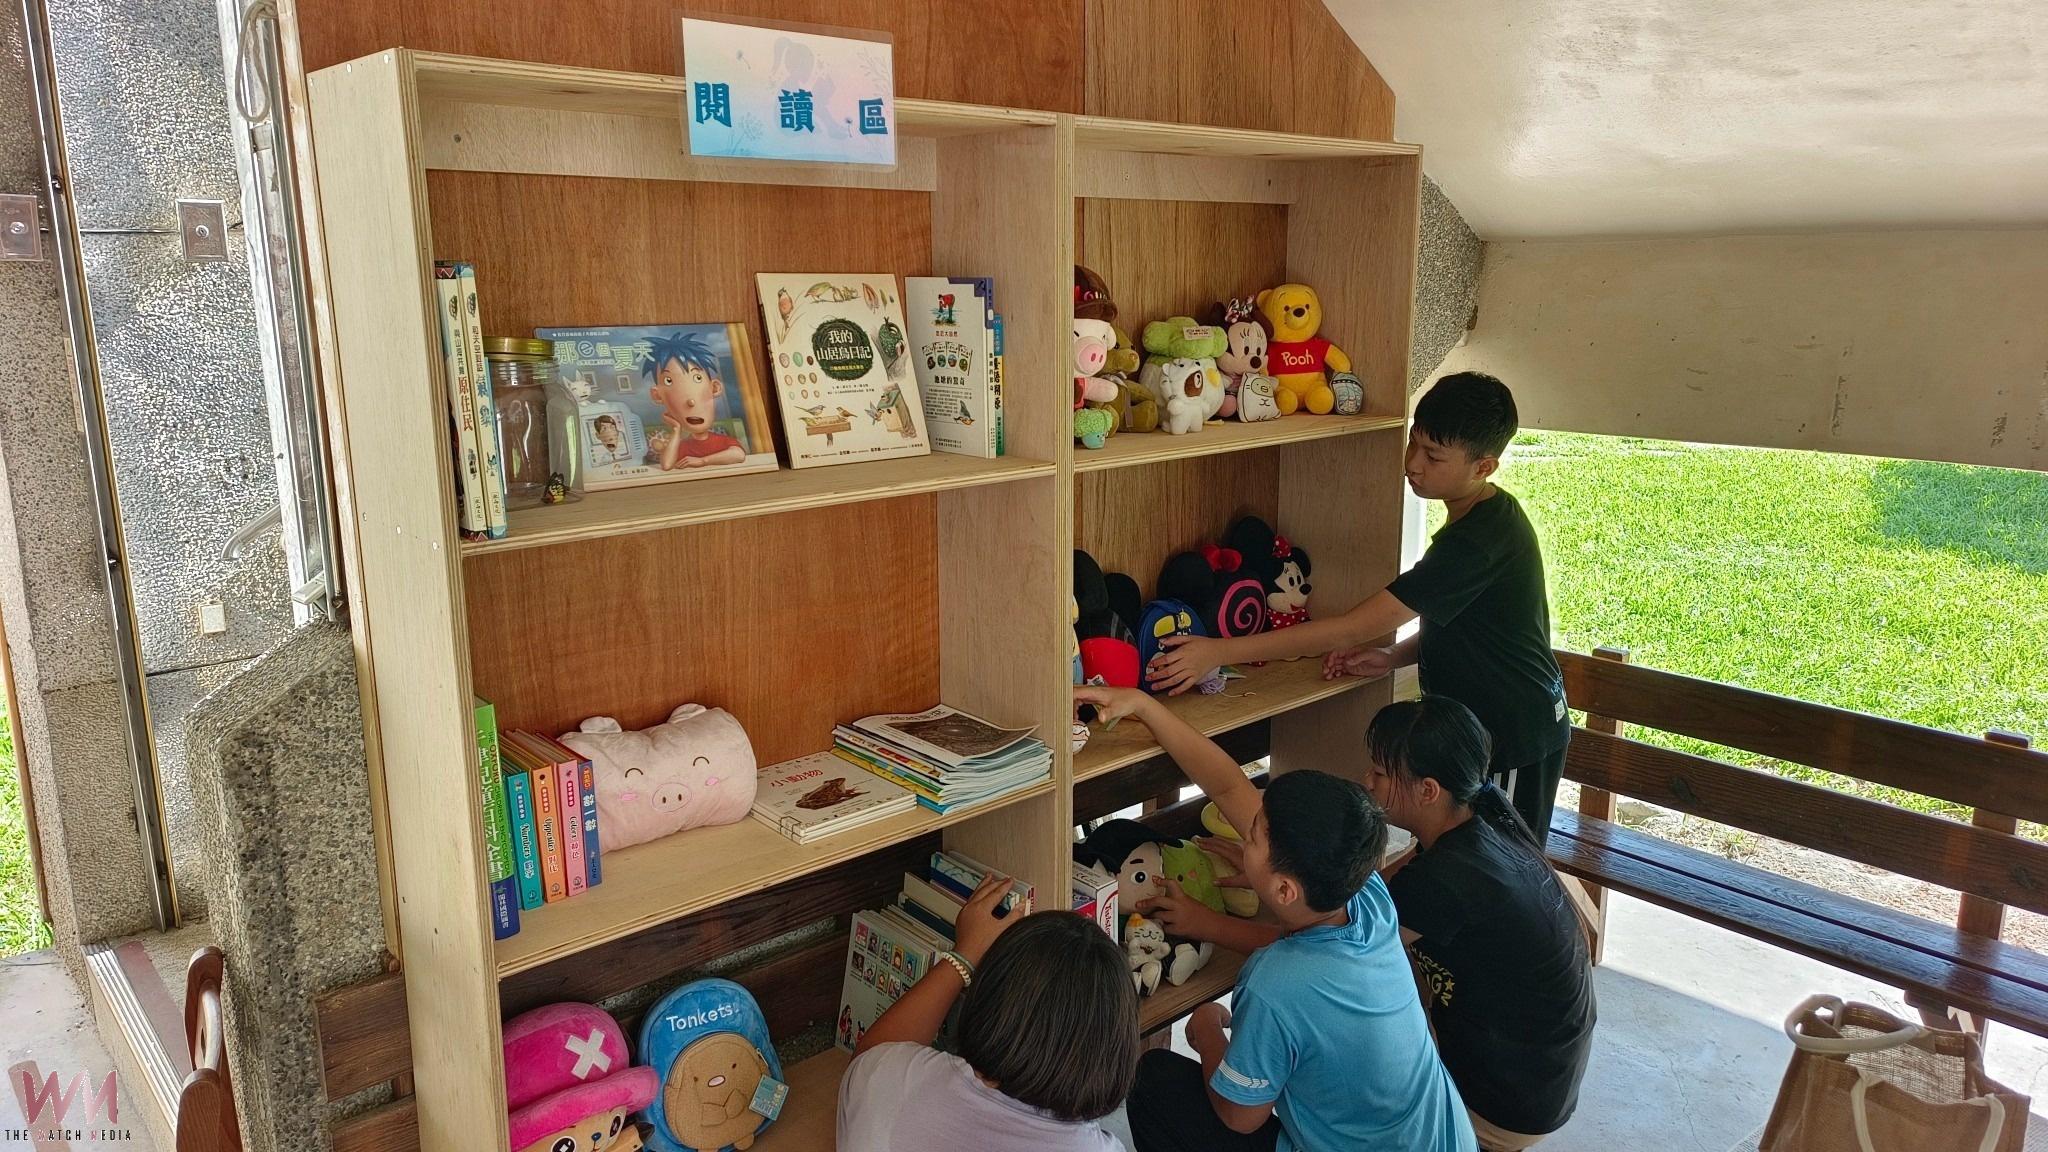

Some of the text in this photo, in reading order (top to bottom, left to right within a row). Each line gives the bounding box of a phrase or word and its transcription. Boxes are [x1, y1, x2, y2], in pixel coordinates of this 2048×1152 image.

[694, 81, 888, 135] 閱讀區
[816, 346, 872, 360] 山居鳥日記
[828, 330, 853, 343] 我的
[1281, 351, 1314, 367] Pooh
[458, 376, 473, 431] 原住民
[490, 744, 500, 784] OXFORD
[499, 825, 511, 876] ENCYCLOPEDIA
[569, 815, 579, 839] Colors
[583, 793, 597, 832] 猜一猜
[521, 823, 531, 858] Numbers
[543, 817, 555, 852] Opposites
